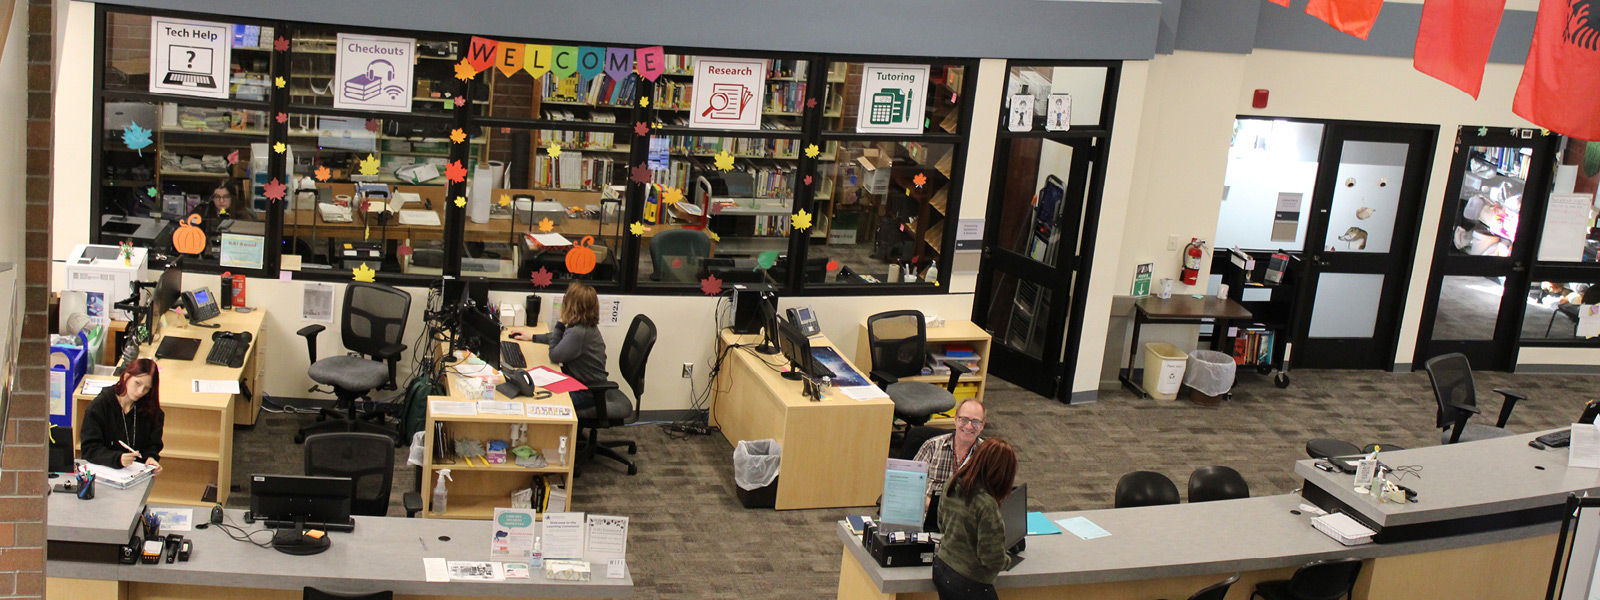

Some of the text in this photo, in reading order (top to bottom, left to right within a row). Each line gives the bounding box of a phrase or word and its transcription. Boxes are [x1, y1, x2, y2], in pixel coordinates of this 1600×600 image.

[165, 27, 218, 42] Tech Help
[347, 43, 405, 56] Checkouts
[472, 41, 656, 73] WELCOME
[708, 65, 752, 76] Research
[876, 71, 916, 83] Tutoring
[611, 300, 621, 323] 2024
